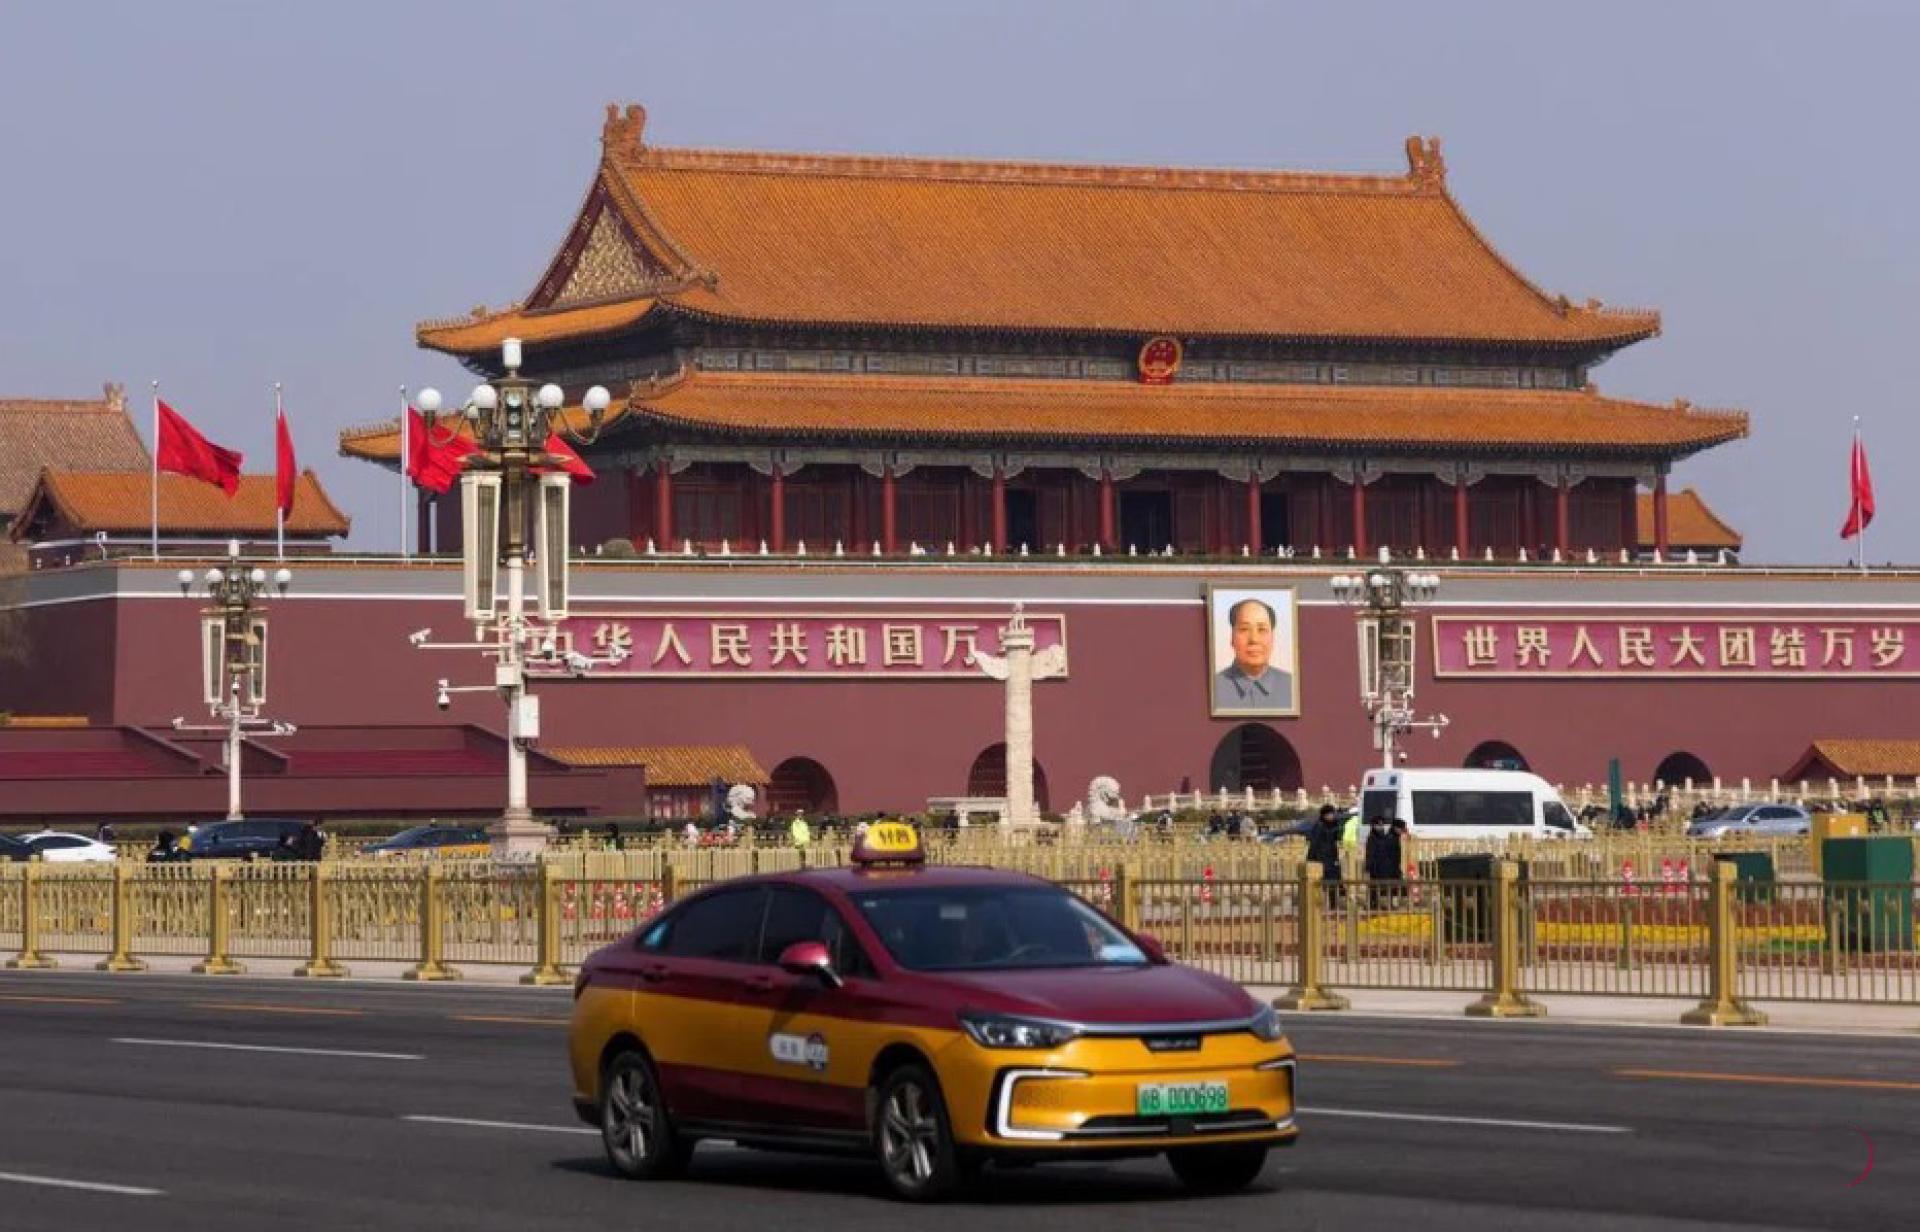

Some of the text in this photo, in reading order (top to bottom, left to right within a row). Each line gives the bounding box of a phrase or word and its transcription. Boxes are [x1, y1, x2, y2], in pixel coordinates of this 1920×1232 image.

[530, 622, 1035, 667] 中华人民共和国万
[1463, 625, 1906, 667] 世界人民大团结万岁
